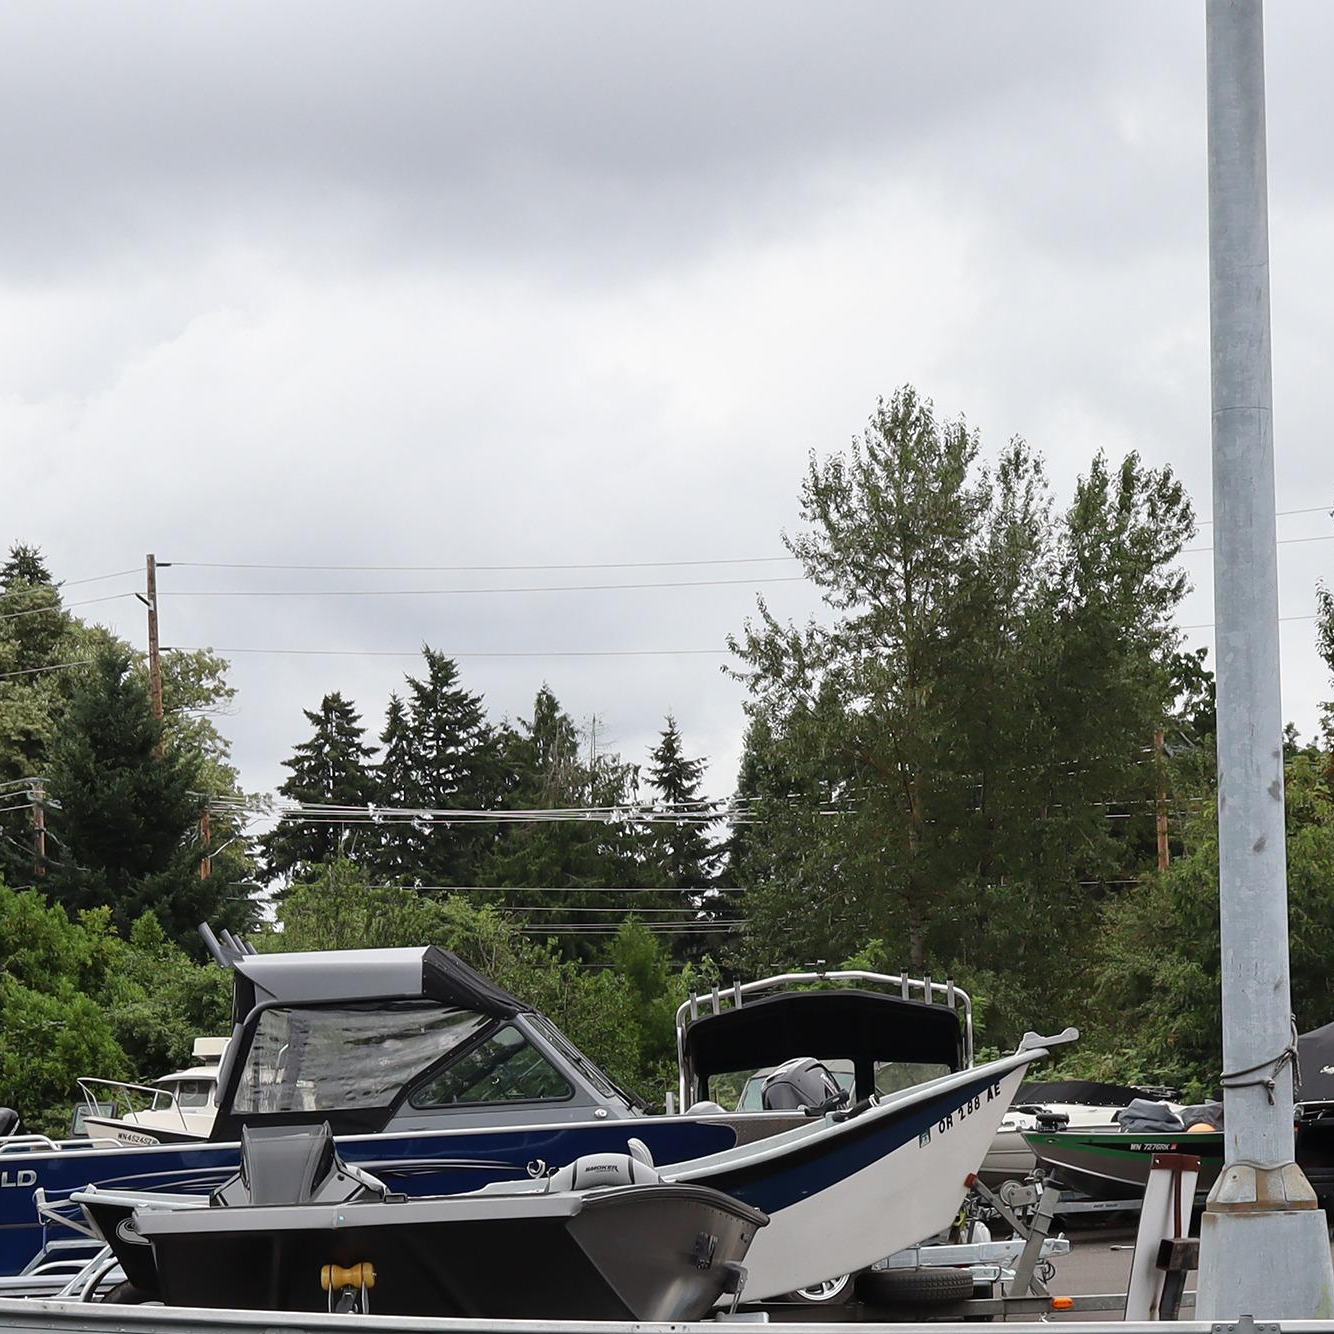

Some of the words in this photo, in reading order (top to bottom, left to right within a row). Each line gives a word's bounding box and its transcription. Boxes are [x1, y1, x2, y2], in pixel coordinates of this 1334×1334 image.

[938, 1113, 954, 1134] OR
[958, 1094, 980, 1121] 288
[987, 1081, 1001, 1104] AE
